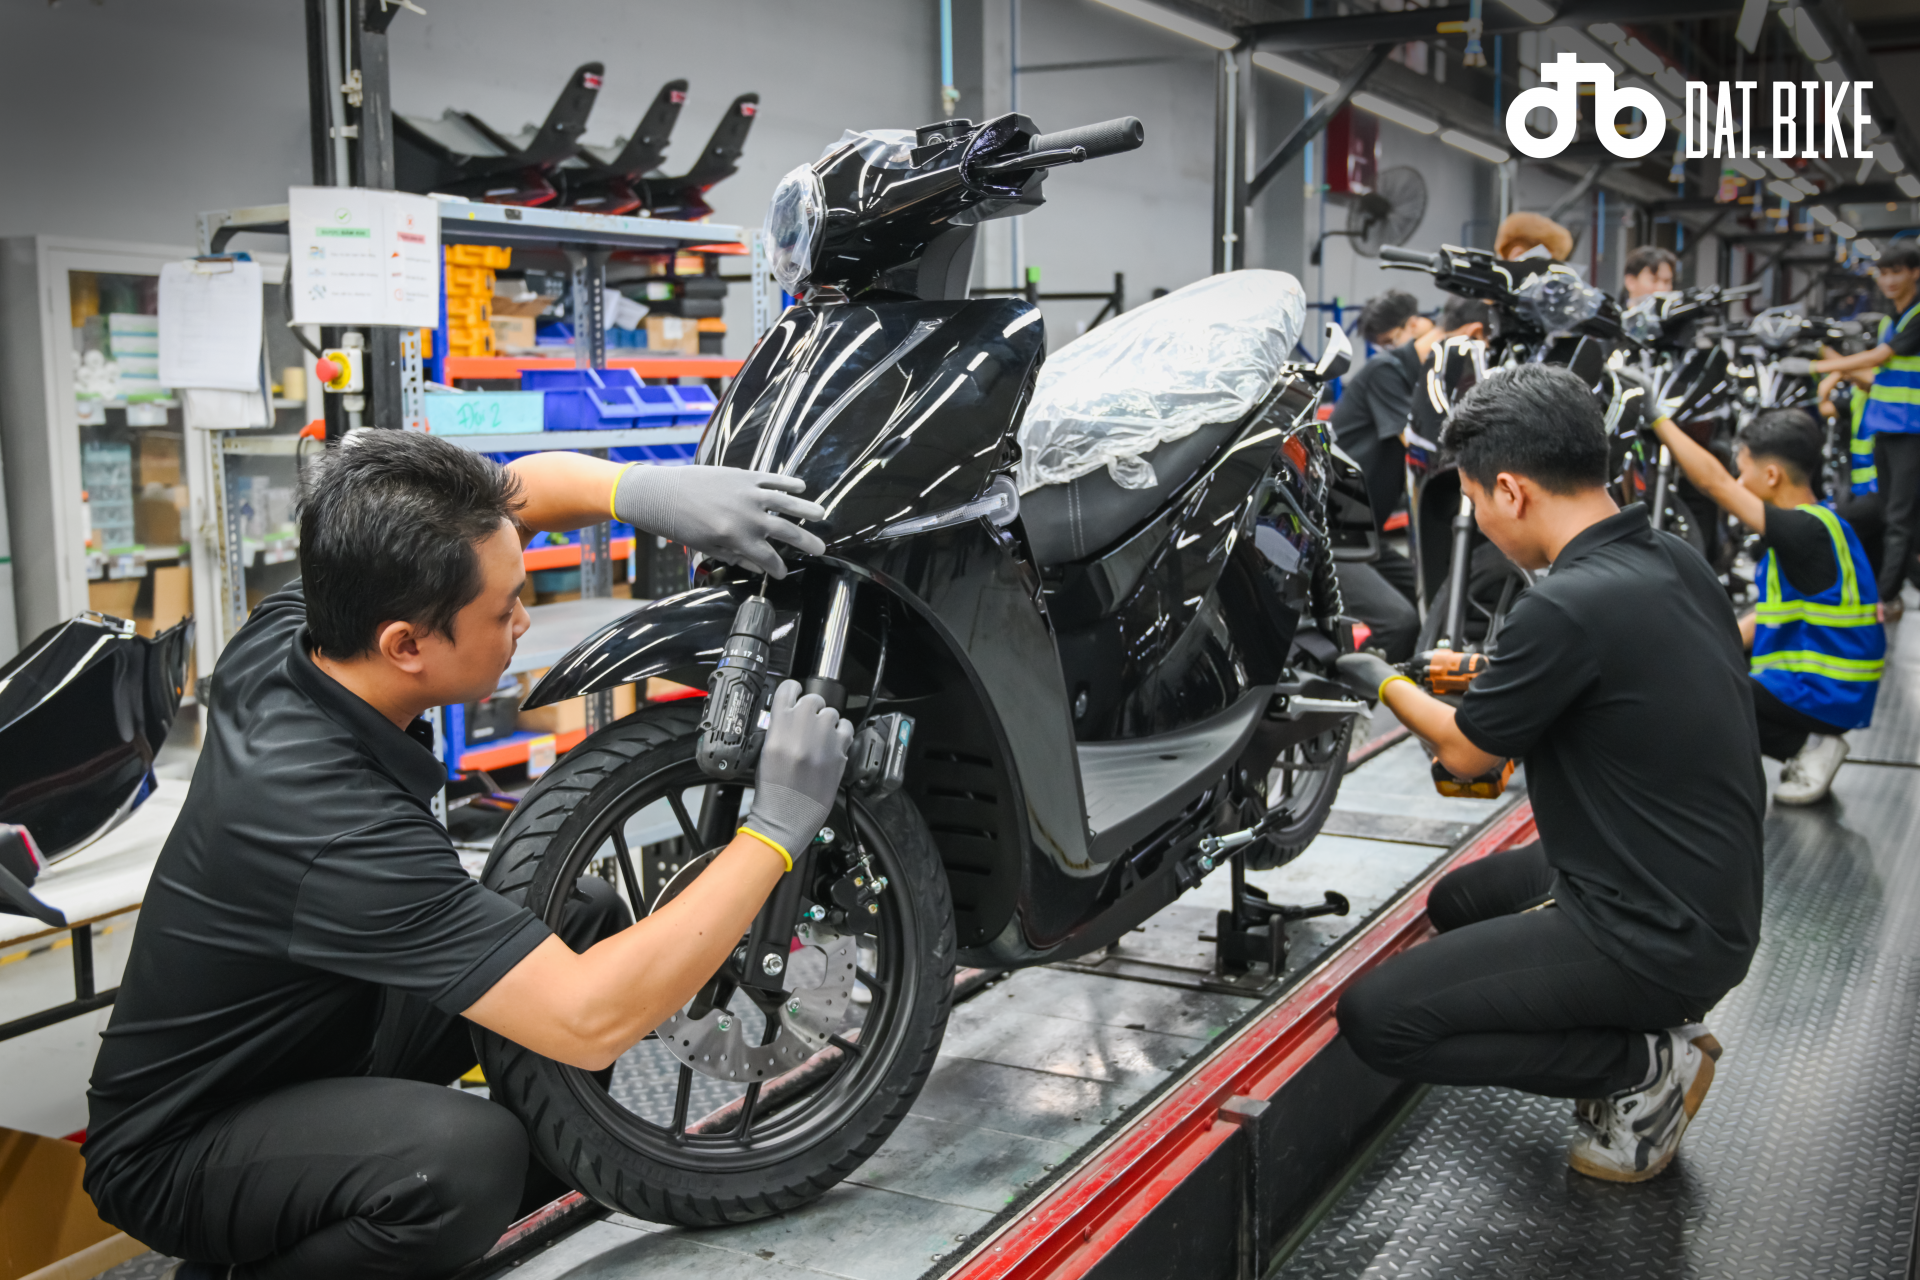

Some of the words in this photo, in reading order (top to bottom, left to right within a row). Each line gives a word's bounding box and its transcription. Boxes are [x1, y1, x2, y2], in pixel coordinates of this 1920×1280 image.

[490, 402, 502, 428] 2
[743, 650, 752, 658] 17
[756, 654, 764, 663] 20
